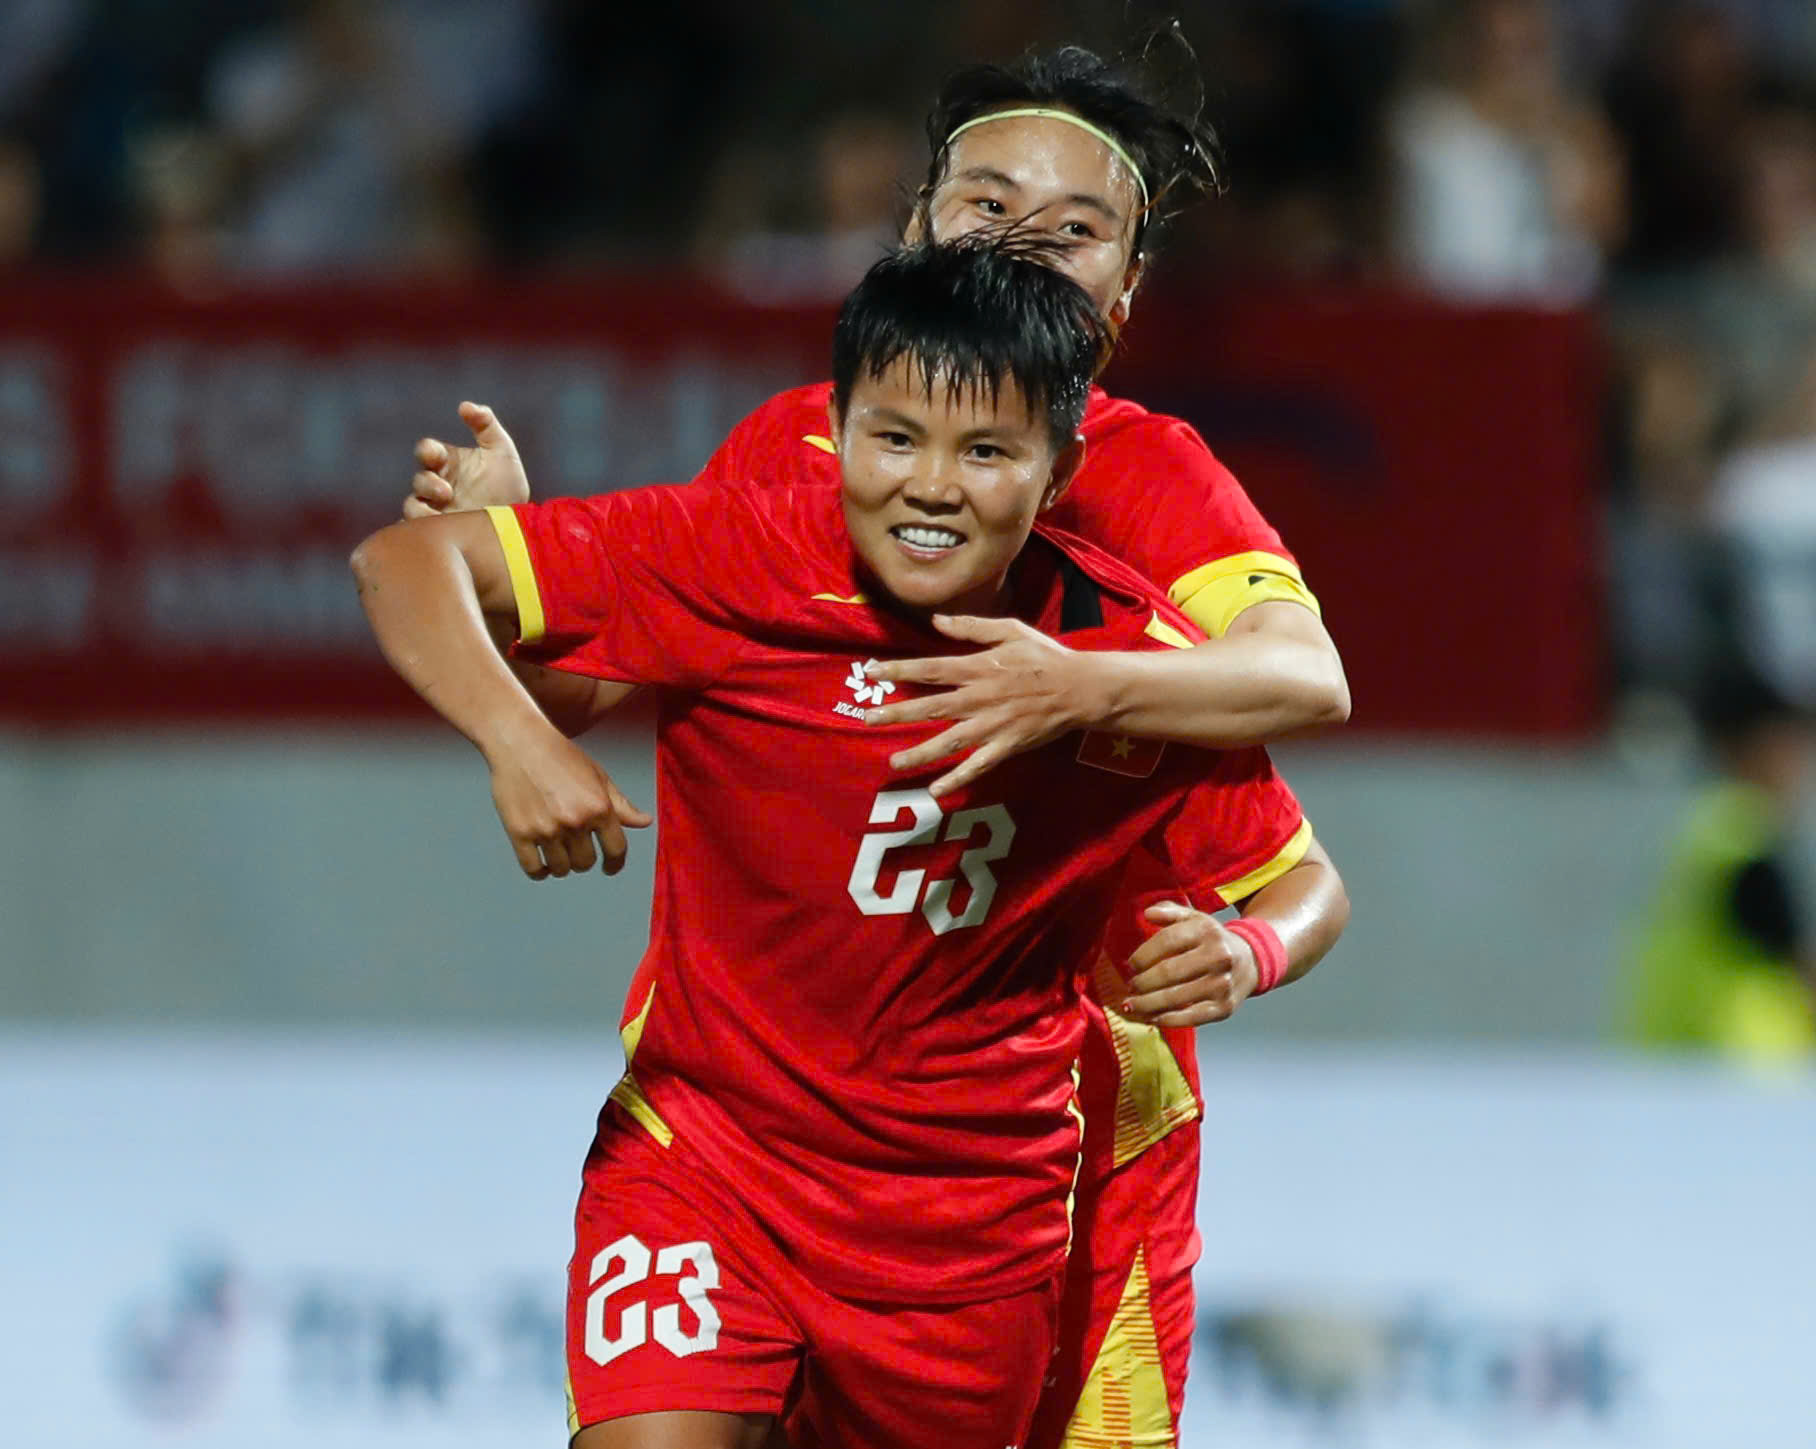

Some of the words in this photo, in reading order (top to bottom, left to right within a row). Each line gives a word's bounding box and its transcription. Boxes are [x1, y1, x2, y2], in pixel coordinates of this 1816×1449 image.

[832, 701, 865, 720] JOGAR
[847, 787, 1016, 936] 23
[584, 1233, 723, 1367] 23
